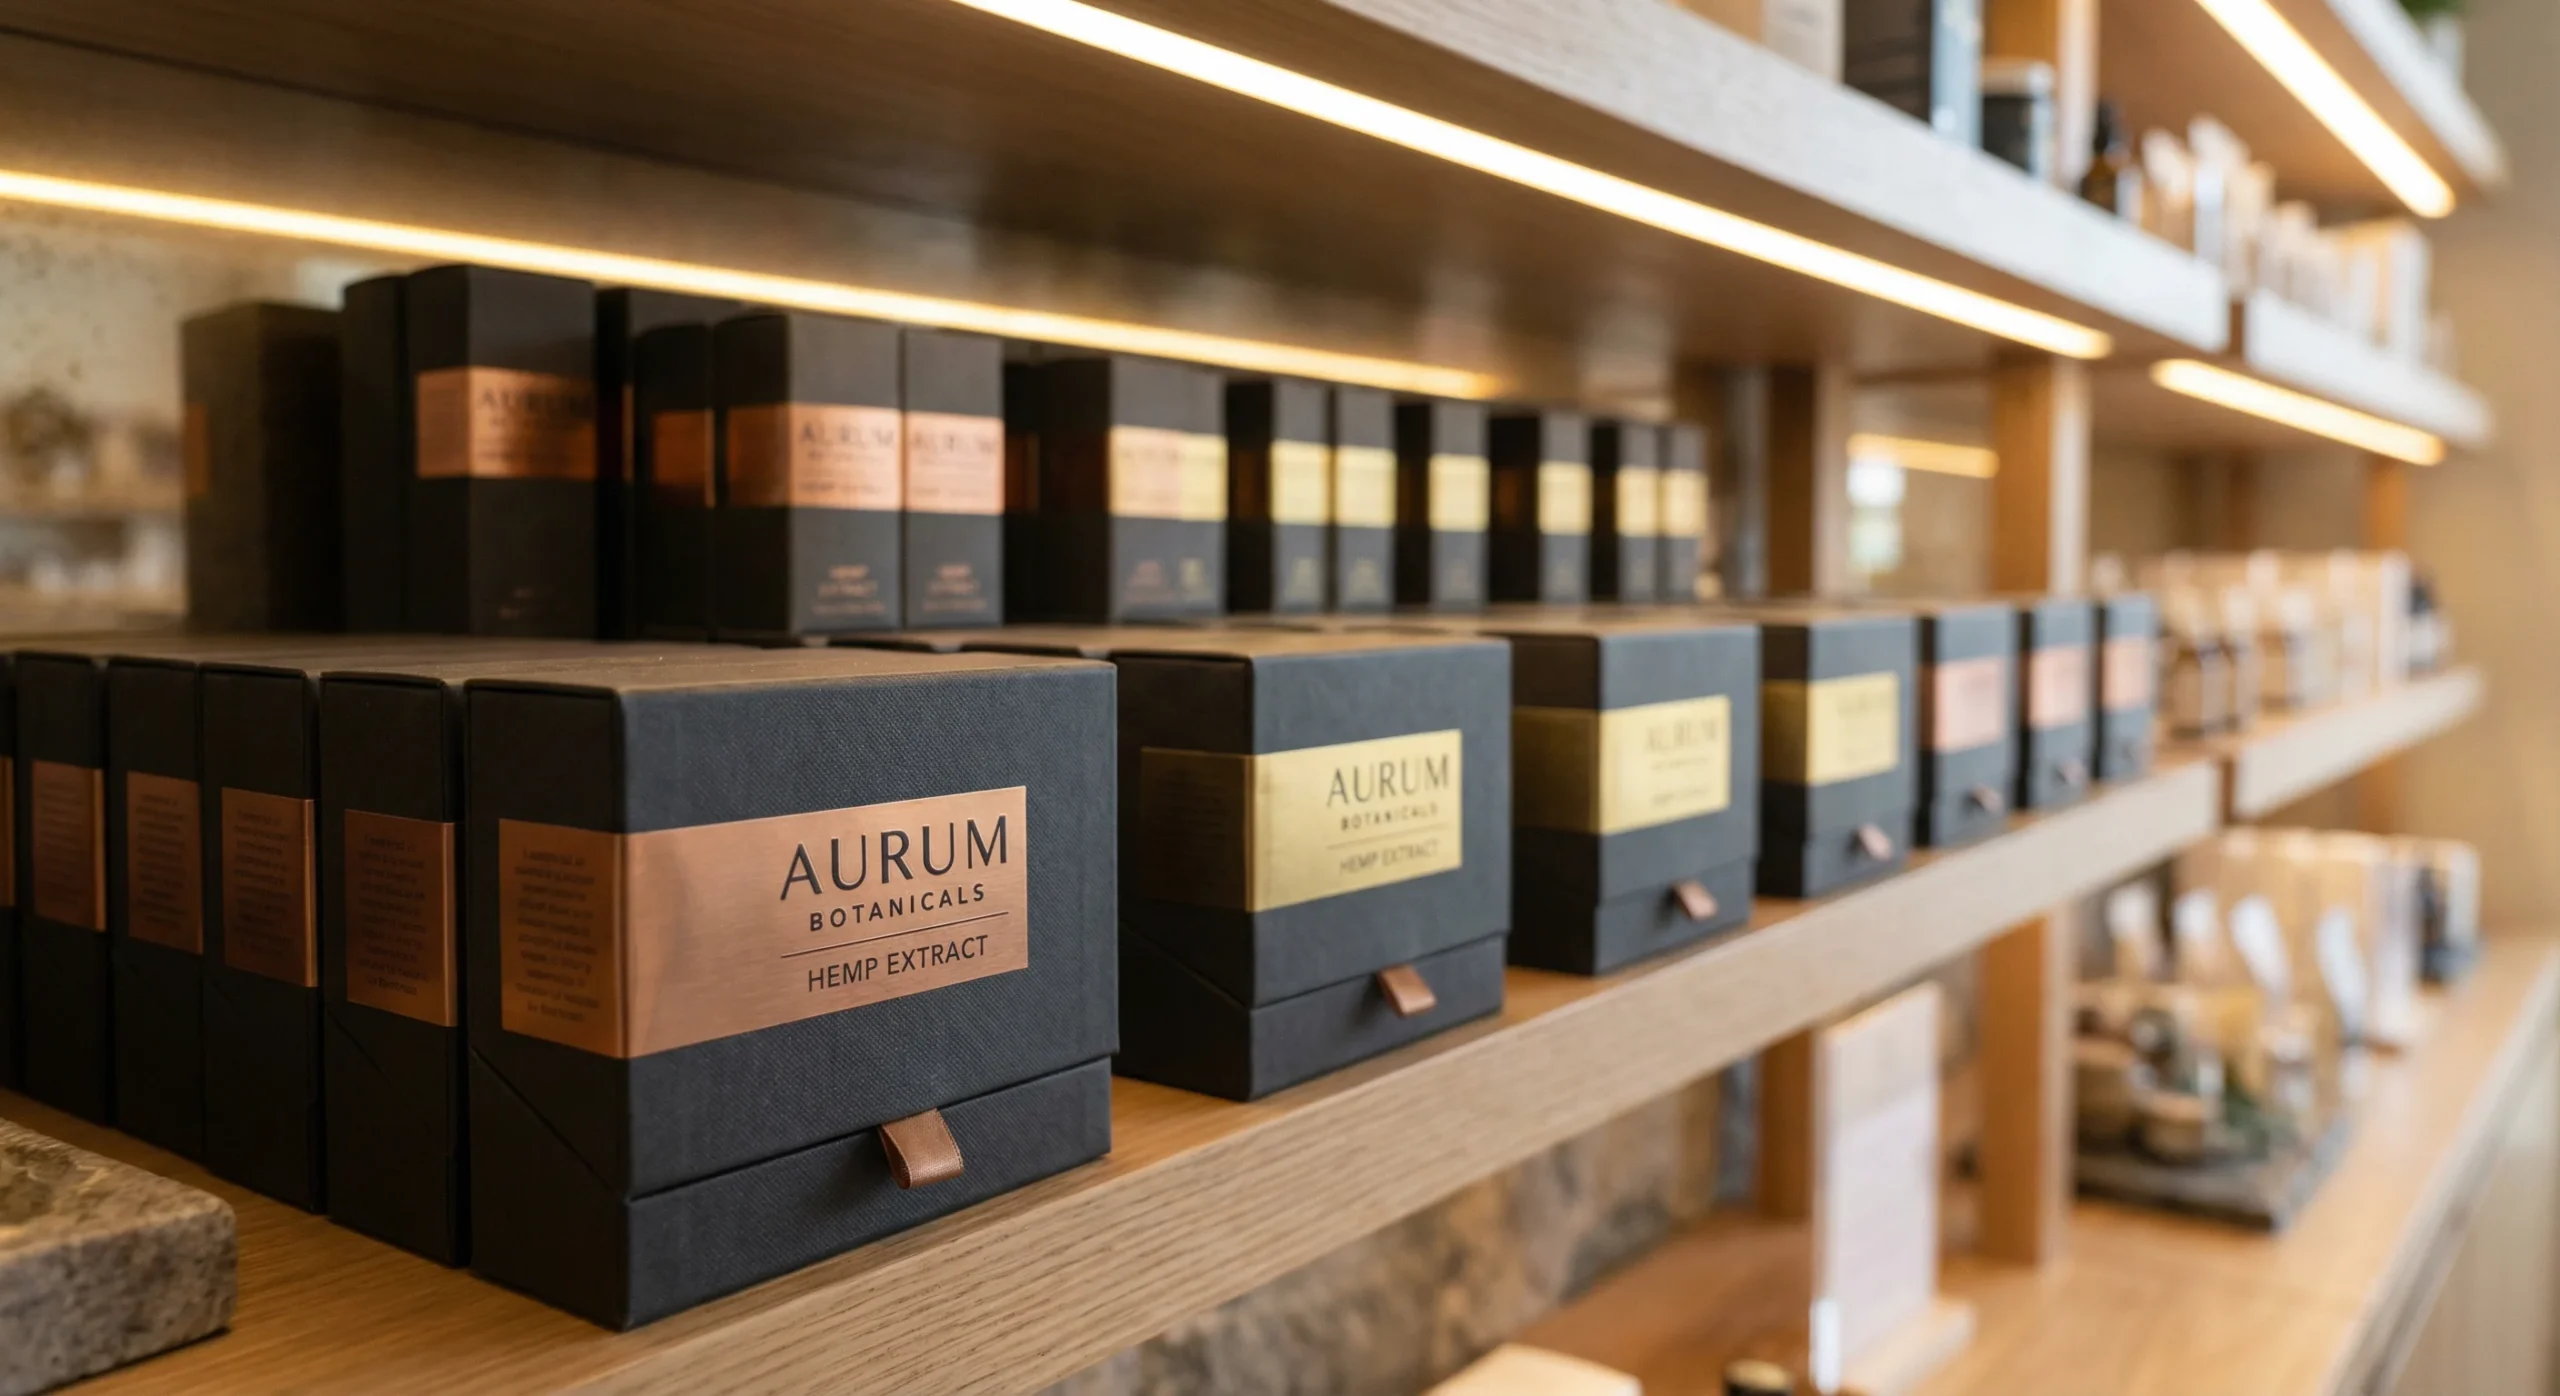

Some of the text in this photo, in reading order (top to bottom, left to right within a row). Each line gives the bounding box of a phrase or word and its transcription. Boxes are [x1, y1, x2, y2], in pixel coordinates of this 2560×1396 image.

[1326, 753, 1449, 808] AURUM
[1341, 801, 1438, 831] BOTANICALS
[780, 815, 1007, 901] AURUM
[1339, 838, 1440, 876] HEMP EXTRACT
[810, 883, 985, 932] BOTANICALS
[808, 934, 989, 992] HEMP EXTRACT
